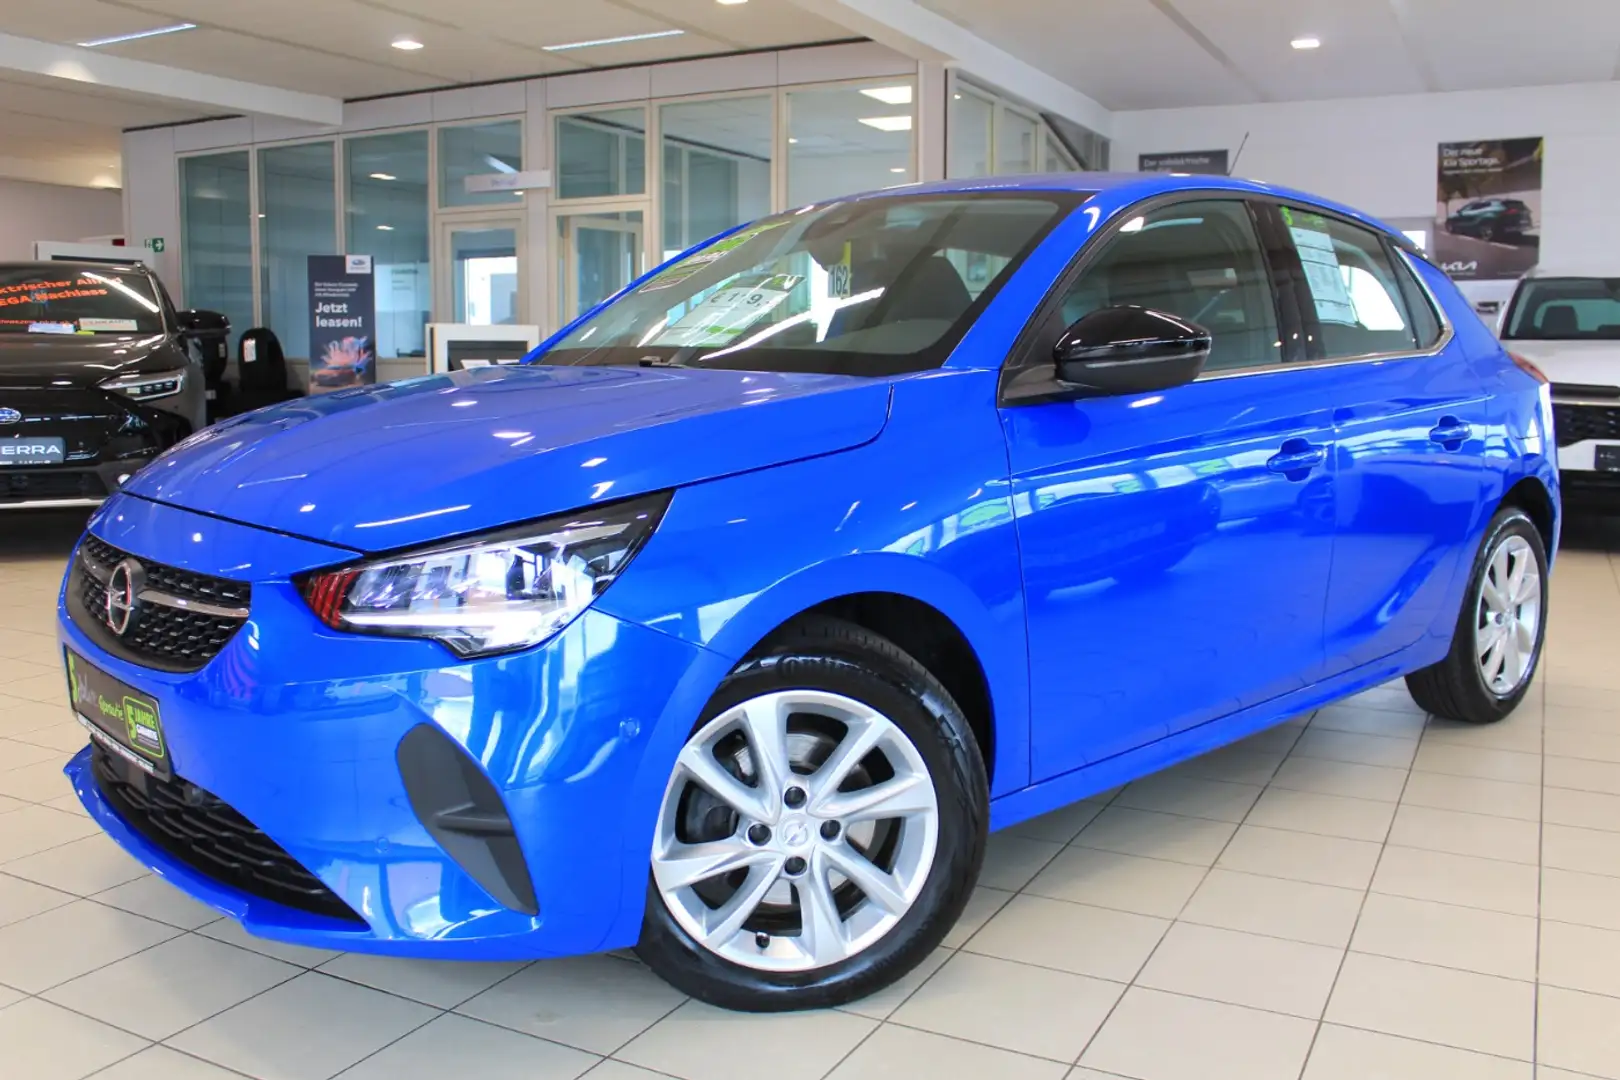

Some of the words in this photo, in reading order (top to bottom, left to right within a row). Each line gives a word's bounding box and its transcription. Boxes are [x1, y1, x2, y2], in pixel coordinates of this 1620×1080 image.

[830, 265, 849, 296] 162
[315, 302, 348, 313] Jetzt
[315, 315, 362, 328] leasen!
